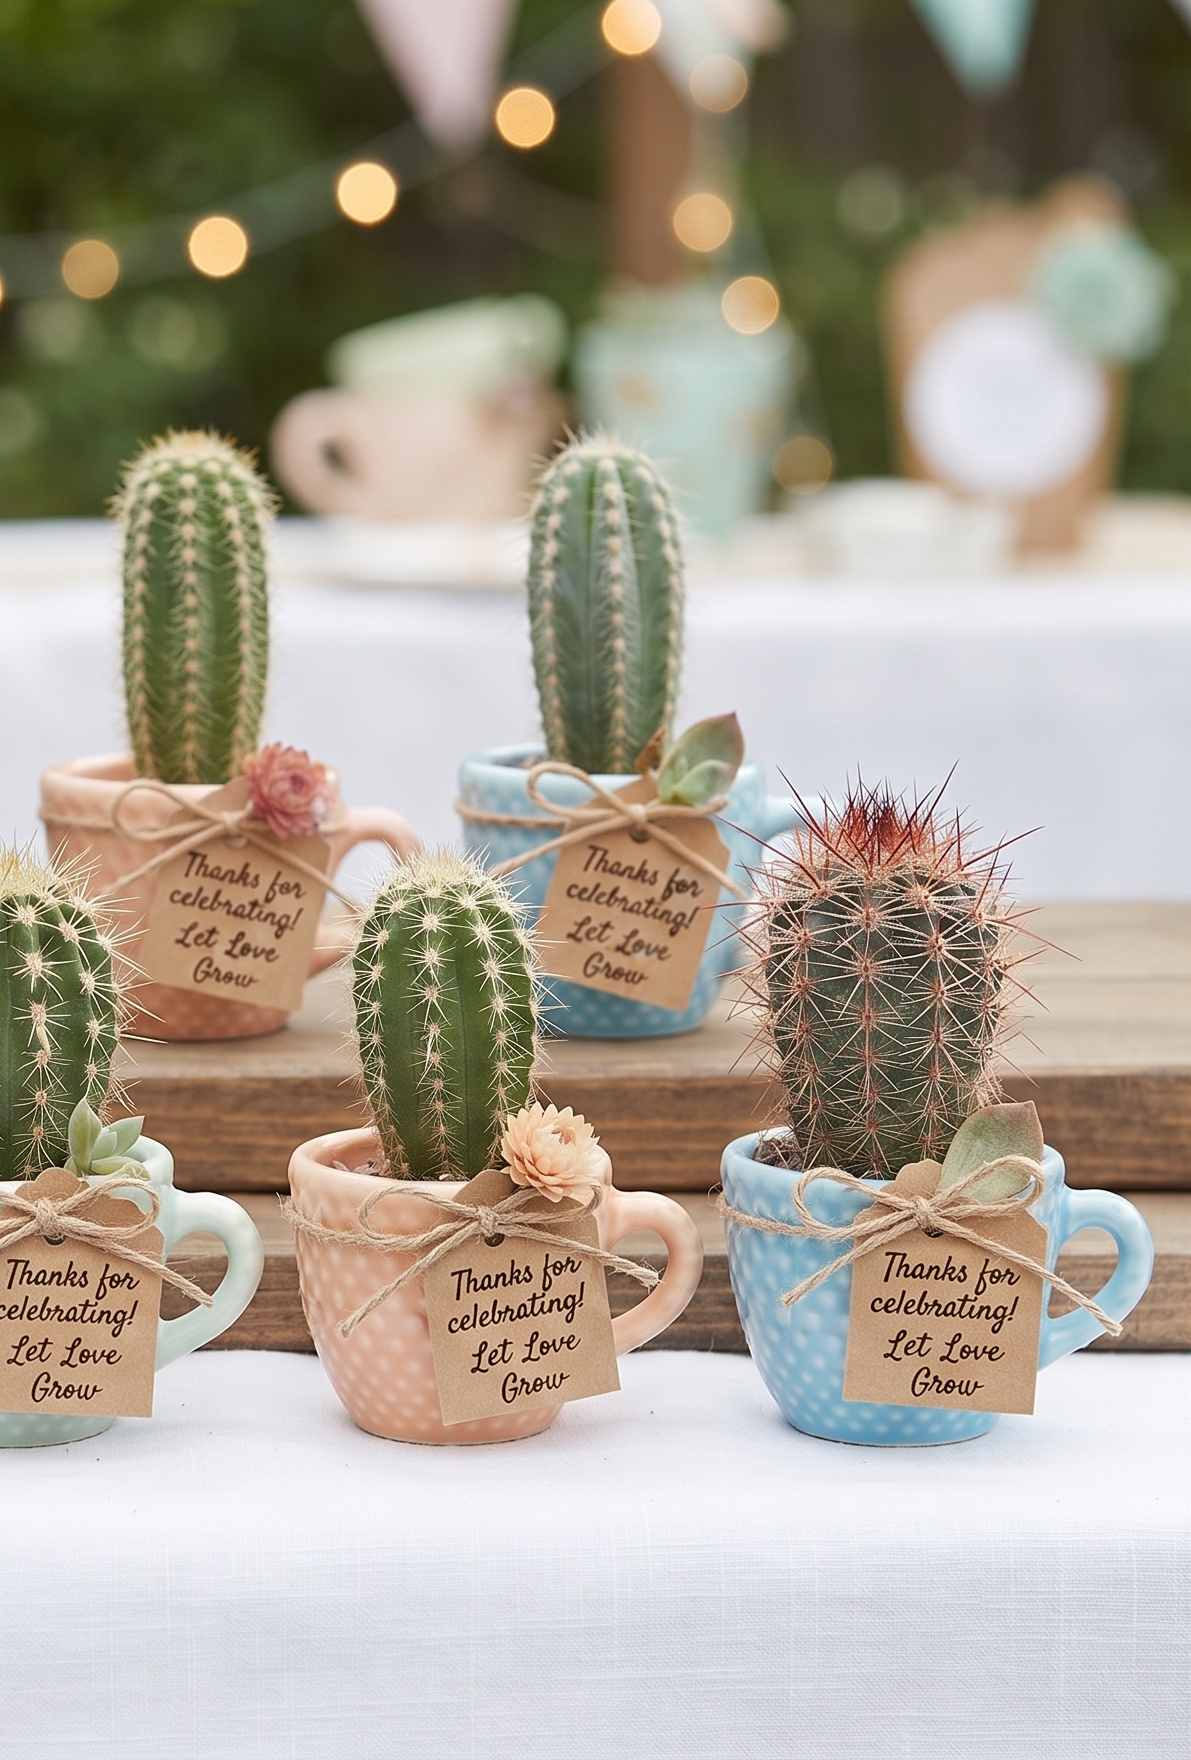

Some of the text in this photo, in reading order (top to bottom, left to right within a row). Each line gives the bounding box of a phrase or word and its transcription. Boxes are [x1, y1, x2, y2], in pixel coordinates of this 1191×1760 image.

[184, 851, 307, 903] Thanks for
[583, 845, 703, 900] Thanks for
[170, 886, 304, 939] celebrating!
[566, 883, 700, 938] celebrating!
[175, 921, 279, 962] Let Love
[566, 916, 671, 960] Let Love
[193, 956, 257, 988] Grow
[583, 952, 649, 985] Grow
[7, 1259, 140, 1300] Thanks for
[451, 1253, 582, 1300] Thanks for
[883, 1252, 1020, 1295] Thanks for
[448, 1282, 585, 1333] celebrating!
[870, 1290, 1019, 1334] celebrating!
[7, 1335, 122, 1368] Let Love
[471, 1331, 581, 1373] Let Love
[883, 1329, 1005, 1363] Let Love
[31, 1372, 103, 1403] Grow
[502, 1372, 570, 1403] Grow
[911, 1367, 984, 1397] Grow
